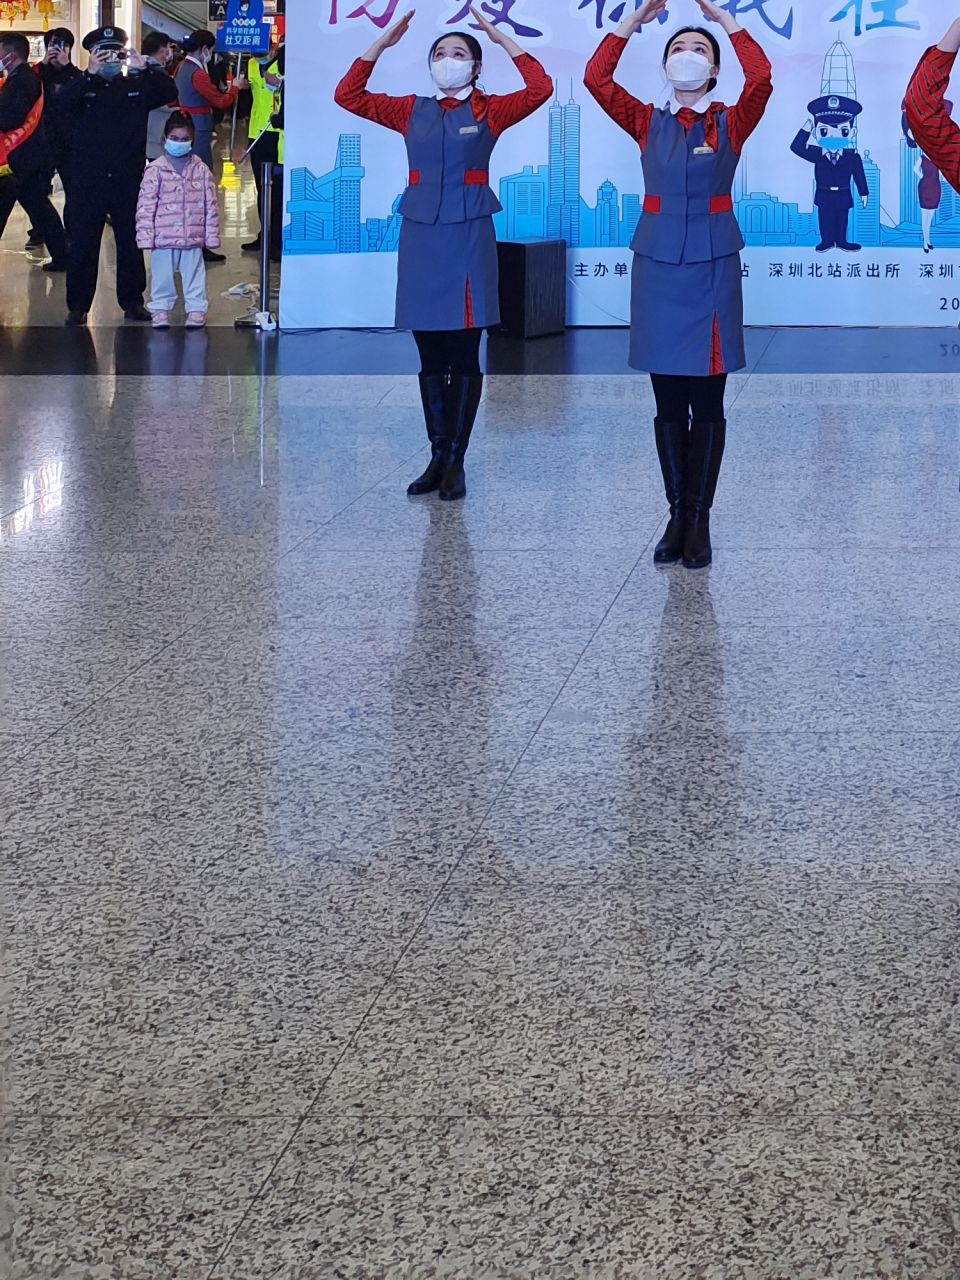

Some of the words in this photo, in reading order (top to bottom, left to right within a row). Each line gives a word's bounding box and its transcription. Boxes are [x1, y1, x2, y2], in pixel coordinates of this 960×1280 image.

[574, 262, 629, 277] 主办单
[768, 262, 901, 278] 深圳北站派出所
